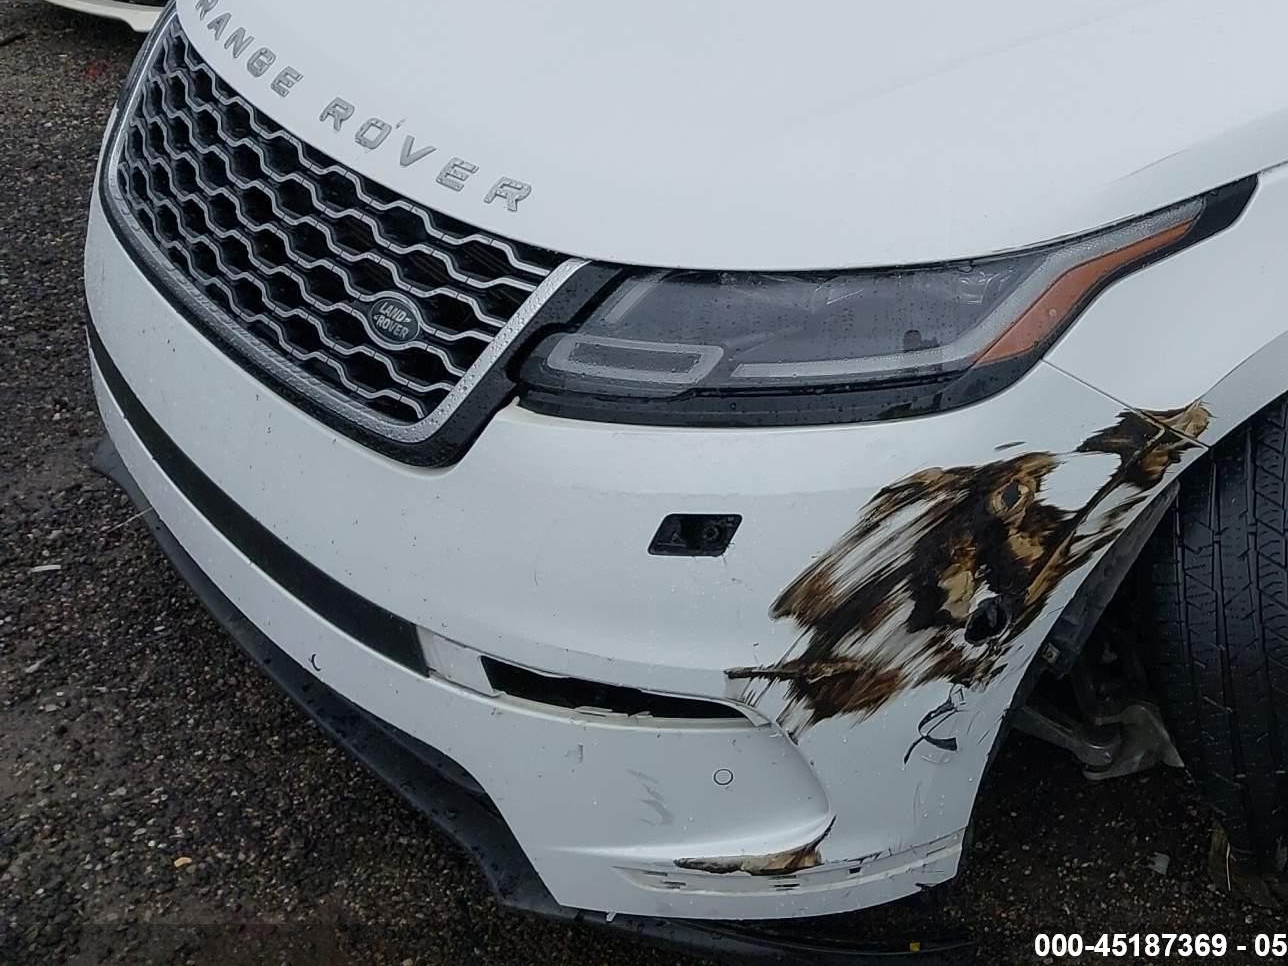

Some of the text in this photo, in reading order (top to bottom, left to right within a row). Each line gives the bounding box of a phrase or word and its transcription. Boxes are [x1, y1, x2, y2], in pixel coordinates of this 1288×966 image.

[319, 96, 534, 213] ROVER
[380, 301, 408, 323] LAND
[376, 314, 410, 339] ROVER
